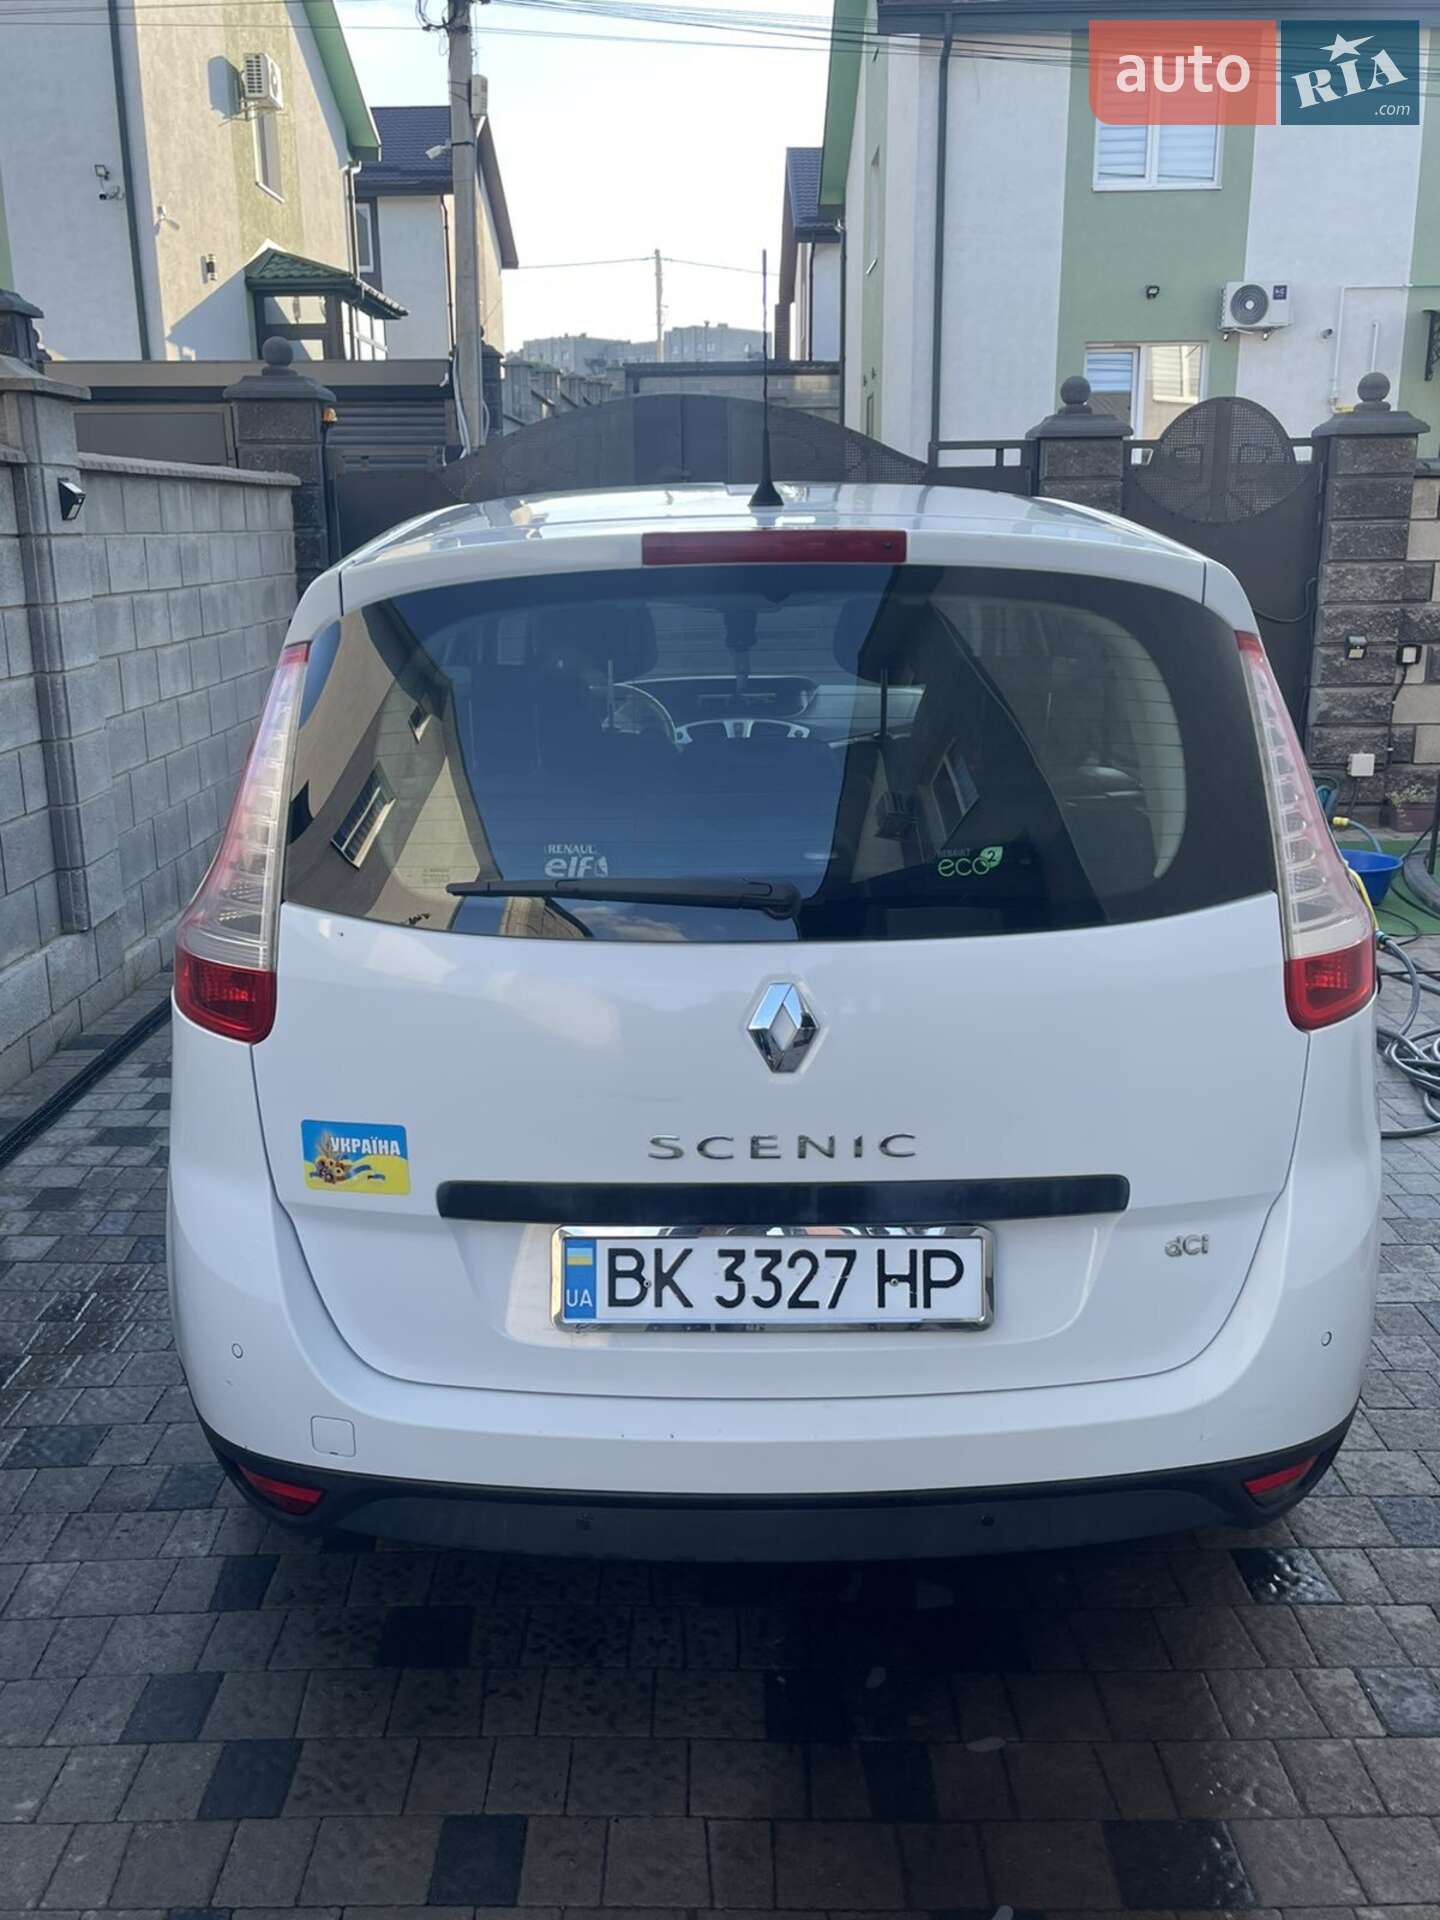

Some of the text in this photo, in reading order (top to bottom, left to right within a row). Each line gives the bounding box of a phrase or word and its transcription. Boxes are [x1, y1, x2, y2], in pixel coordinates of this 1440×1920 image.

[544, 855, 594, 878] elf
[330, 1136, 401, 1156] УКРАЇНА
[648, 1134, 916, 1160] SCENIC
[566, 1248, 965, 1310] UA BK 3327 HP
